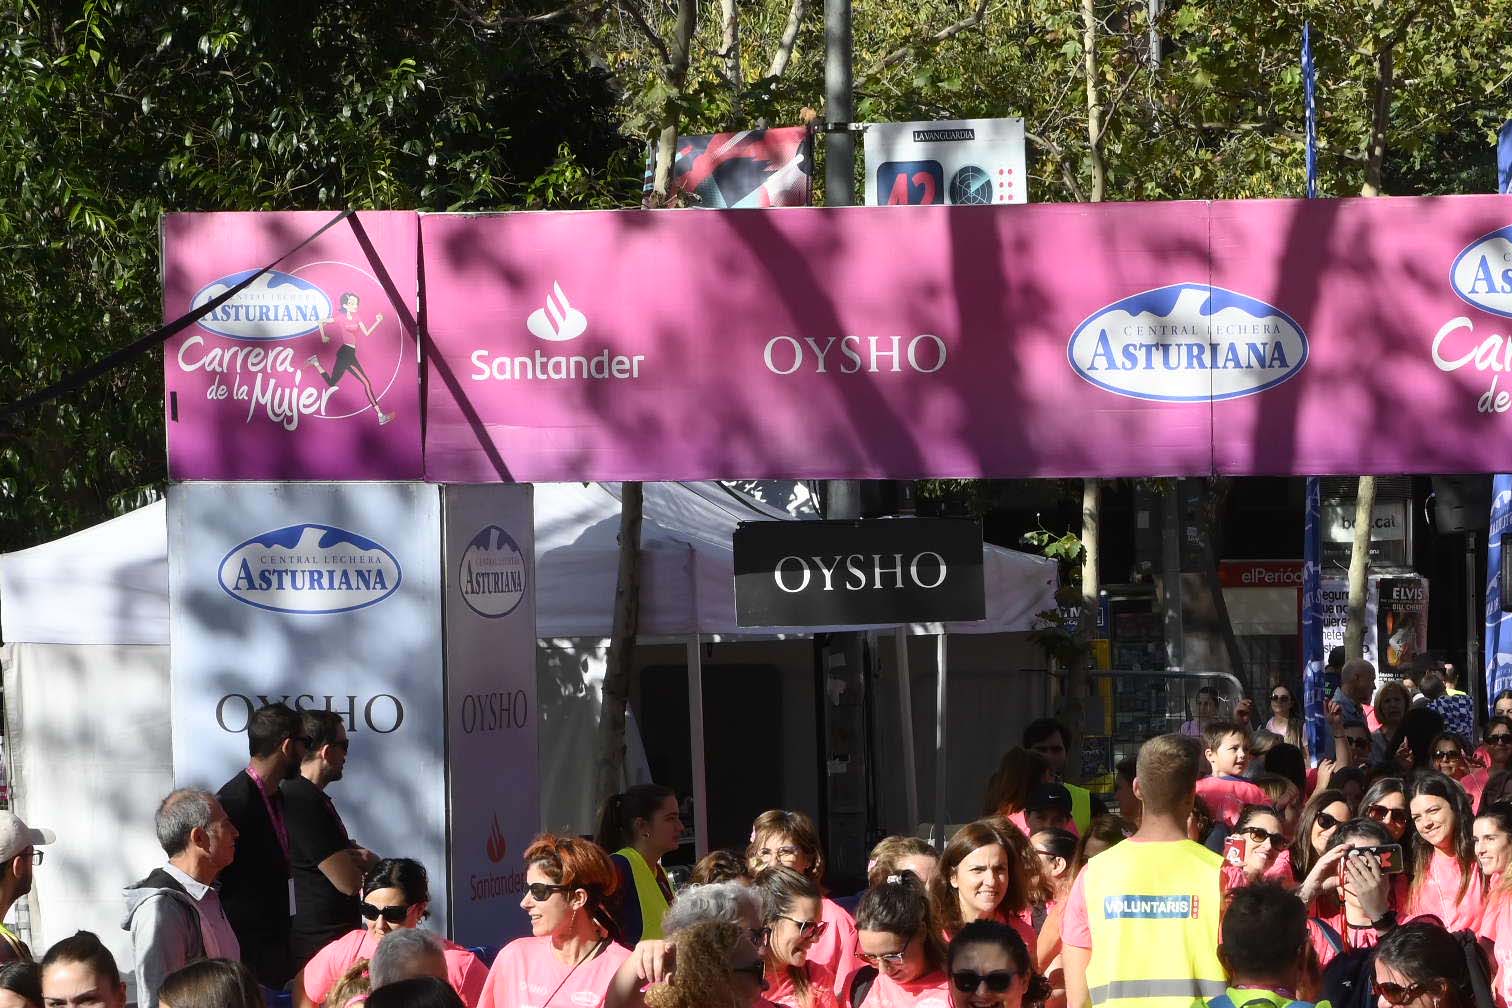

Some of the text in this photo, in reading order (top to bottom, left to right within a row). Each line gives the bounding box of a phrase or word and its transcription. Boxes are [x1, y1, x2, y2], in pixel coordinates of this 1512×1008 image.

[1086, 327, 1289, 371] ASTURIANA
[1123, 324, 1281, 336] CENTRAL LECHERA
[177, 335, 296, 373] Carrera
[471, 349, 645, 379] Santander
[763, 334, 947, 375] OYSHO
[207, 368, 339, 431] de la Mujer
[1478, 374, 1512, 414] de
[232, 557, 389, 592] ASTURIANA
[260, 555, 382, 565] CENTRAL LECHERA
[464, 559, 523, 596] ASTURIANA
[774, 550, 948, 593] OYSHO
[1393, 587, 1423, 600] ELVIS
[216, 694, 405, 733] OHO
[461, 689, 528, 734] OYSHO
[1105, 899, 1189, 913] VOLUNTARIS
